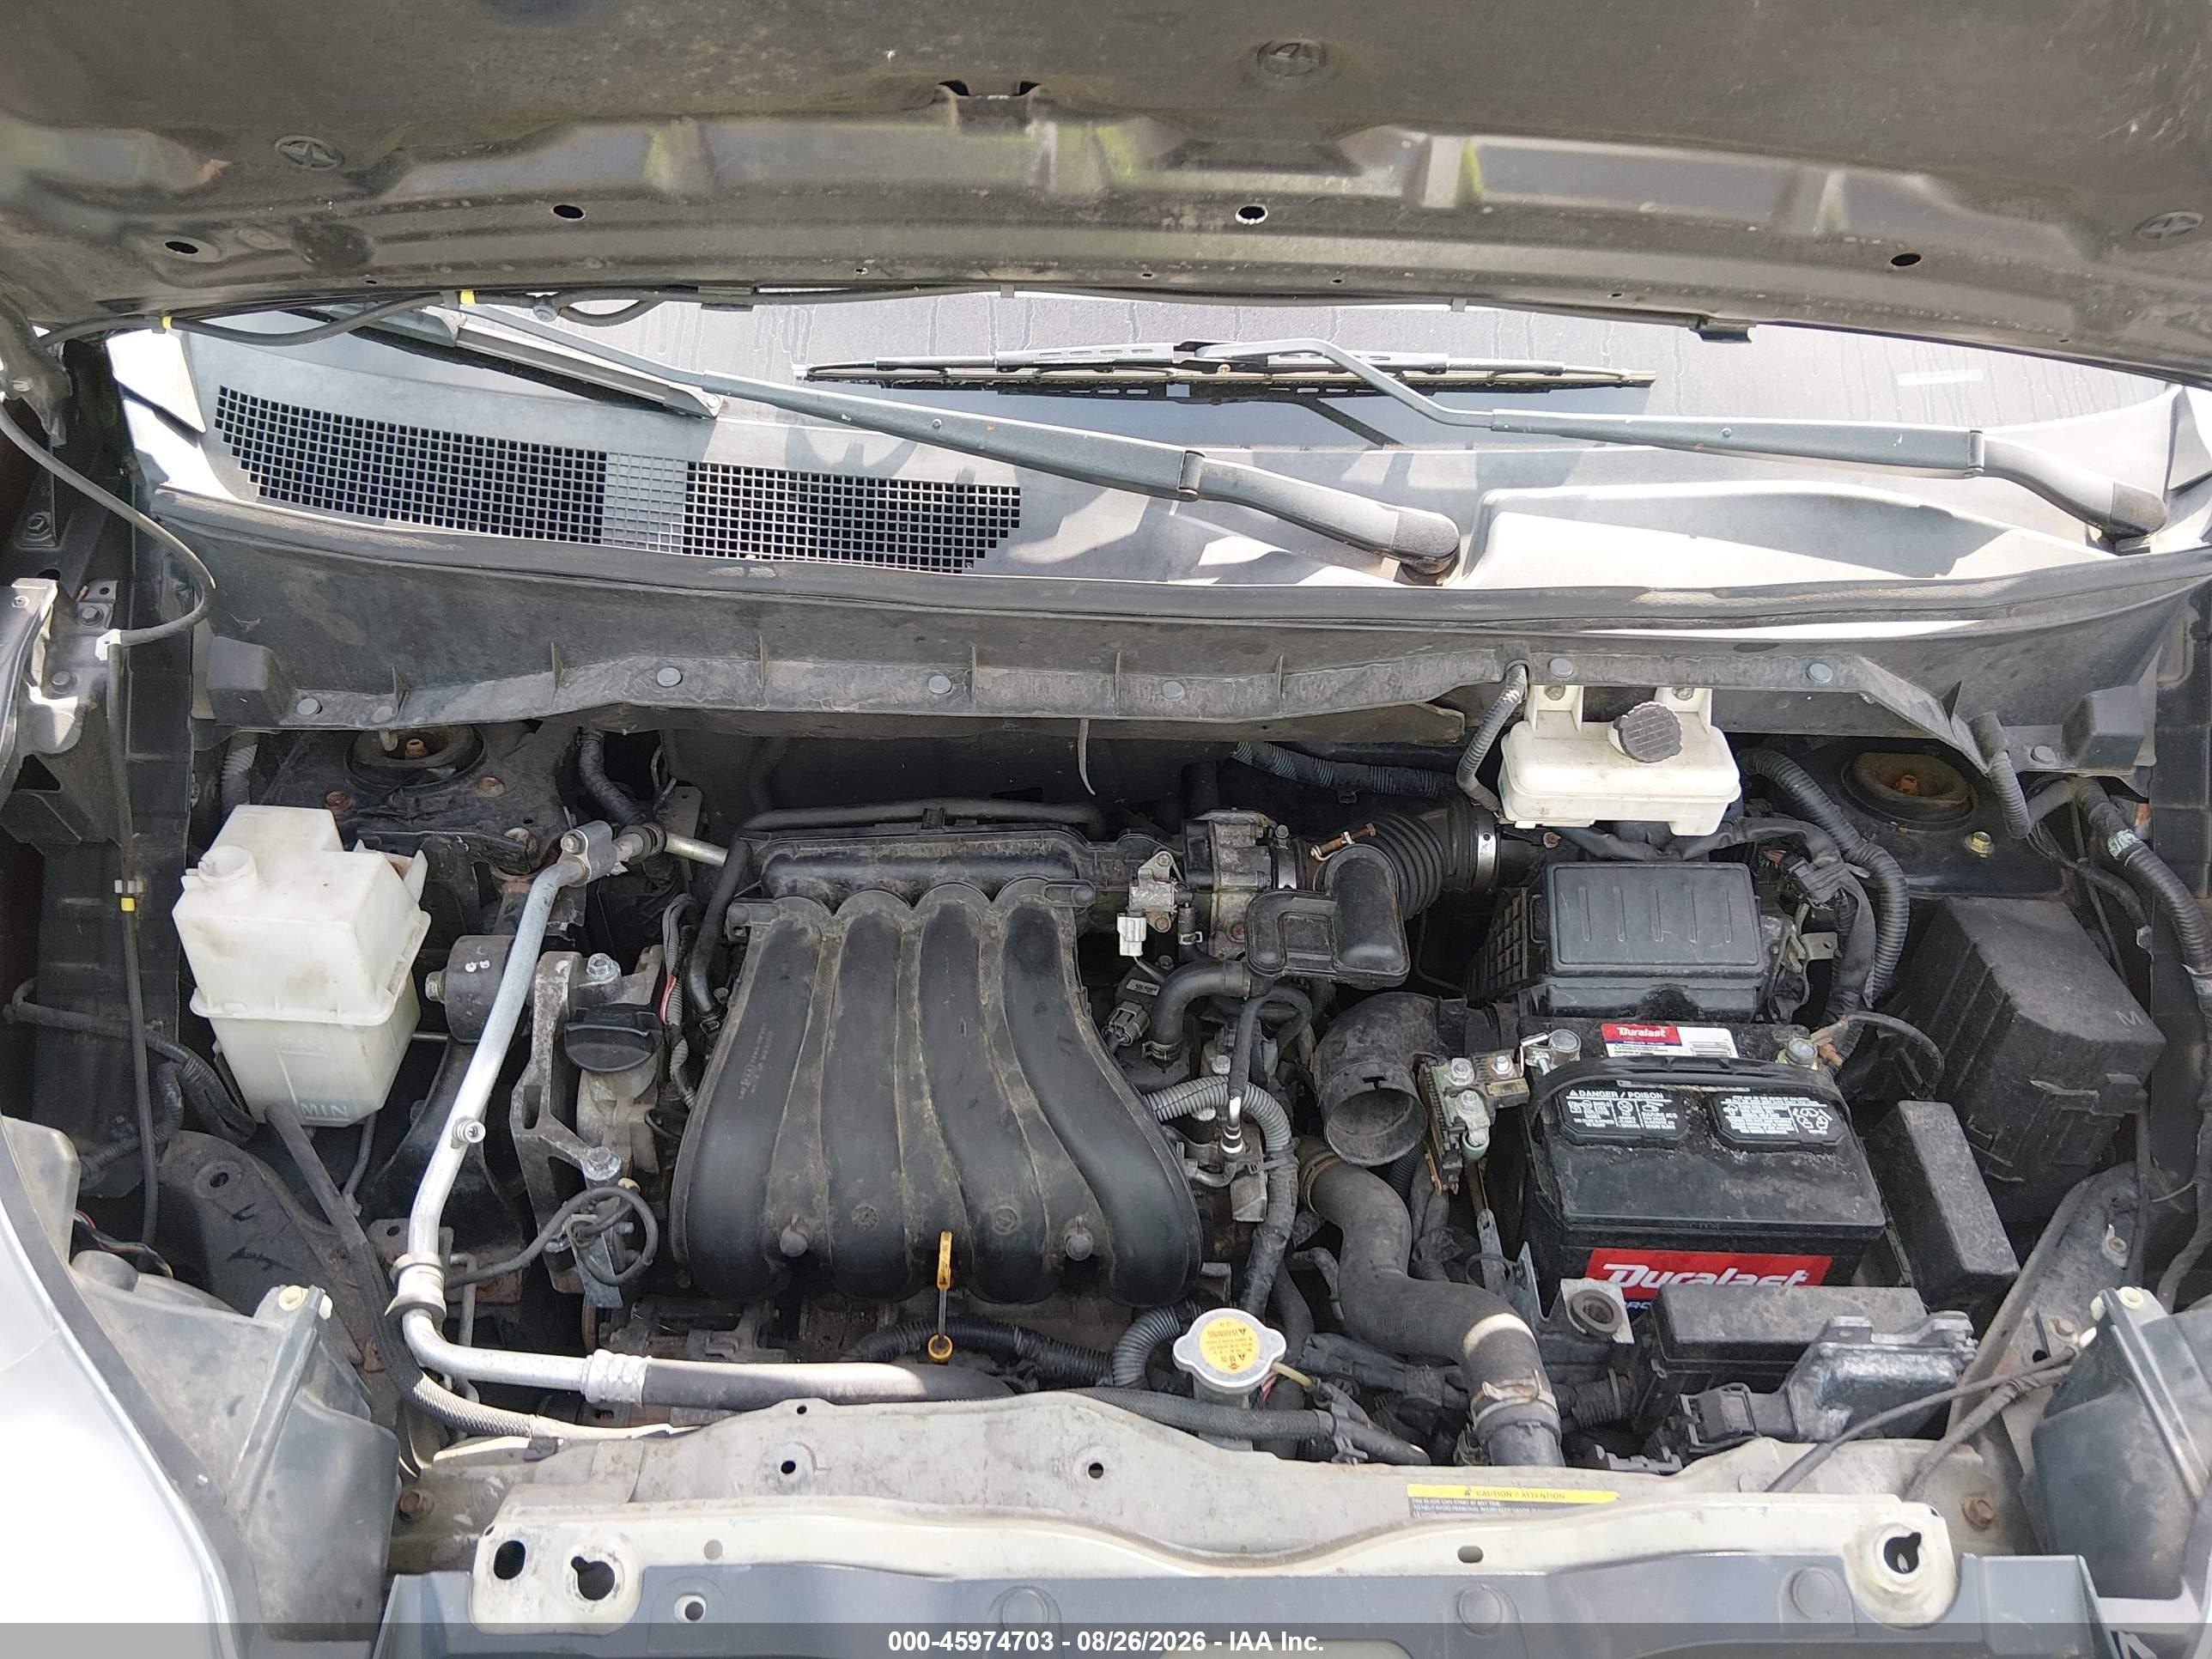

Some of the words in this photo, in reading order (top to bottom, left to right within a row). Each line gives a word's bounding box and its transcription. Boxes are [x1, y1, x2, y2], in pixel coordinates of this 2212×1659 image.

[1616, 1026, 1667, 1037] Duralast
[1578, 1090, 1619, 1098] DANGER
[300, 1103, 349, 1117] MIN
[1476, 1490, 1512, 1498] CAUTION
[1522, 1492, 1565, 1500] ATTENTION
